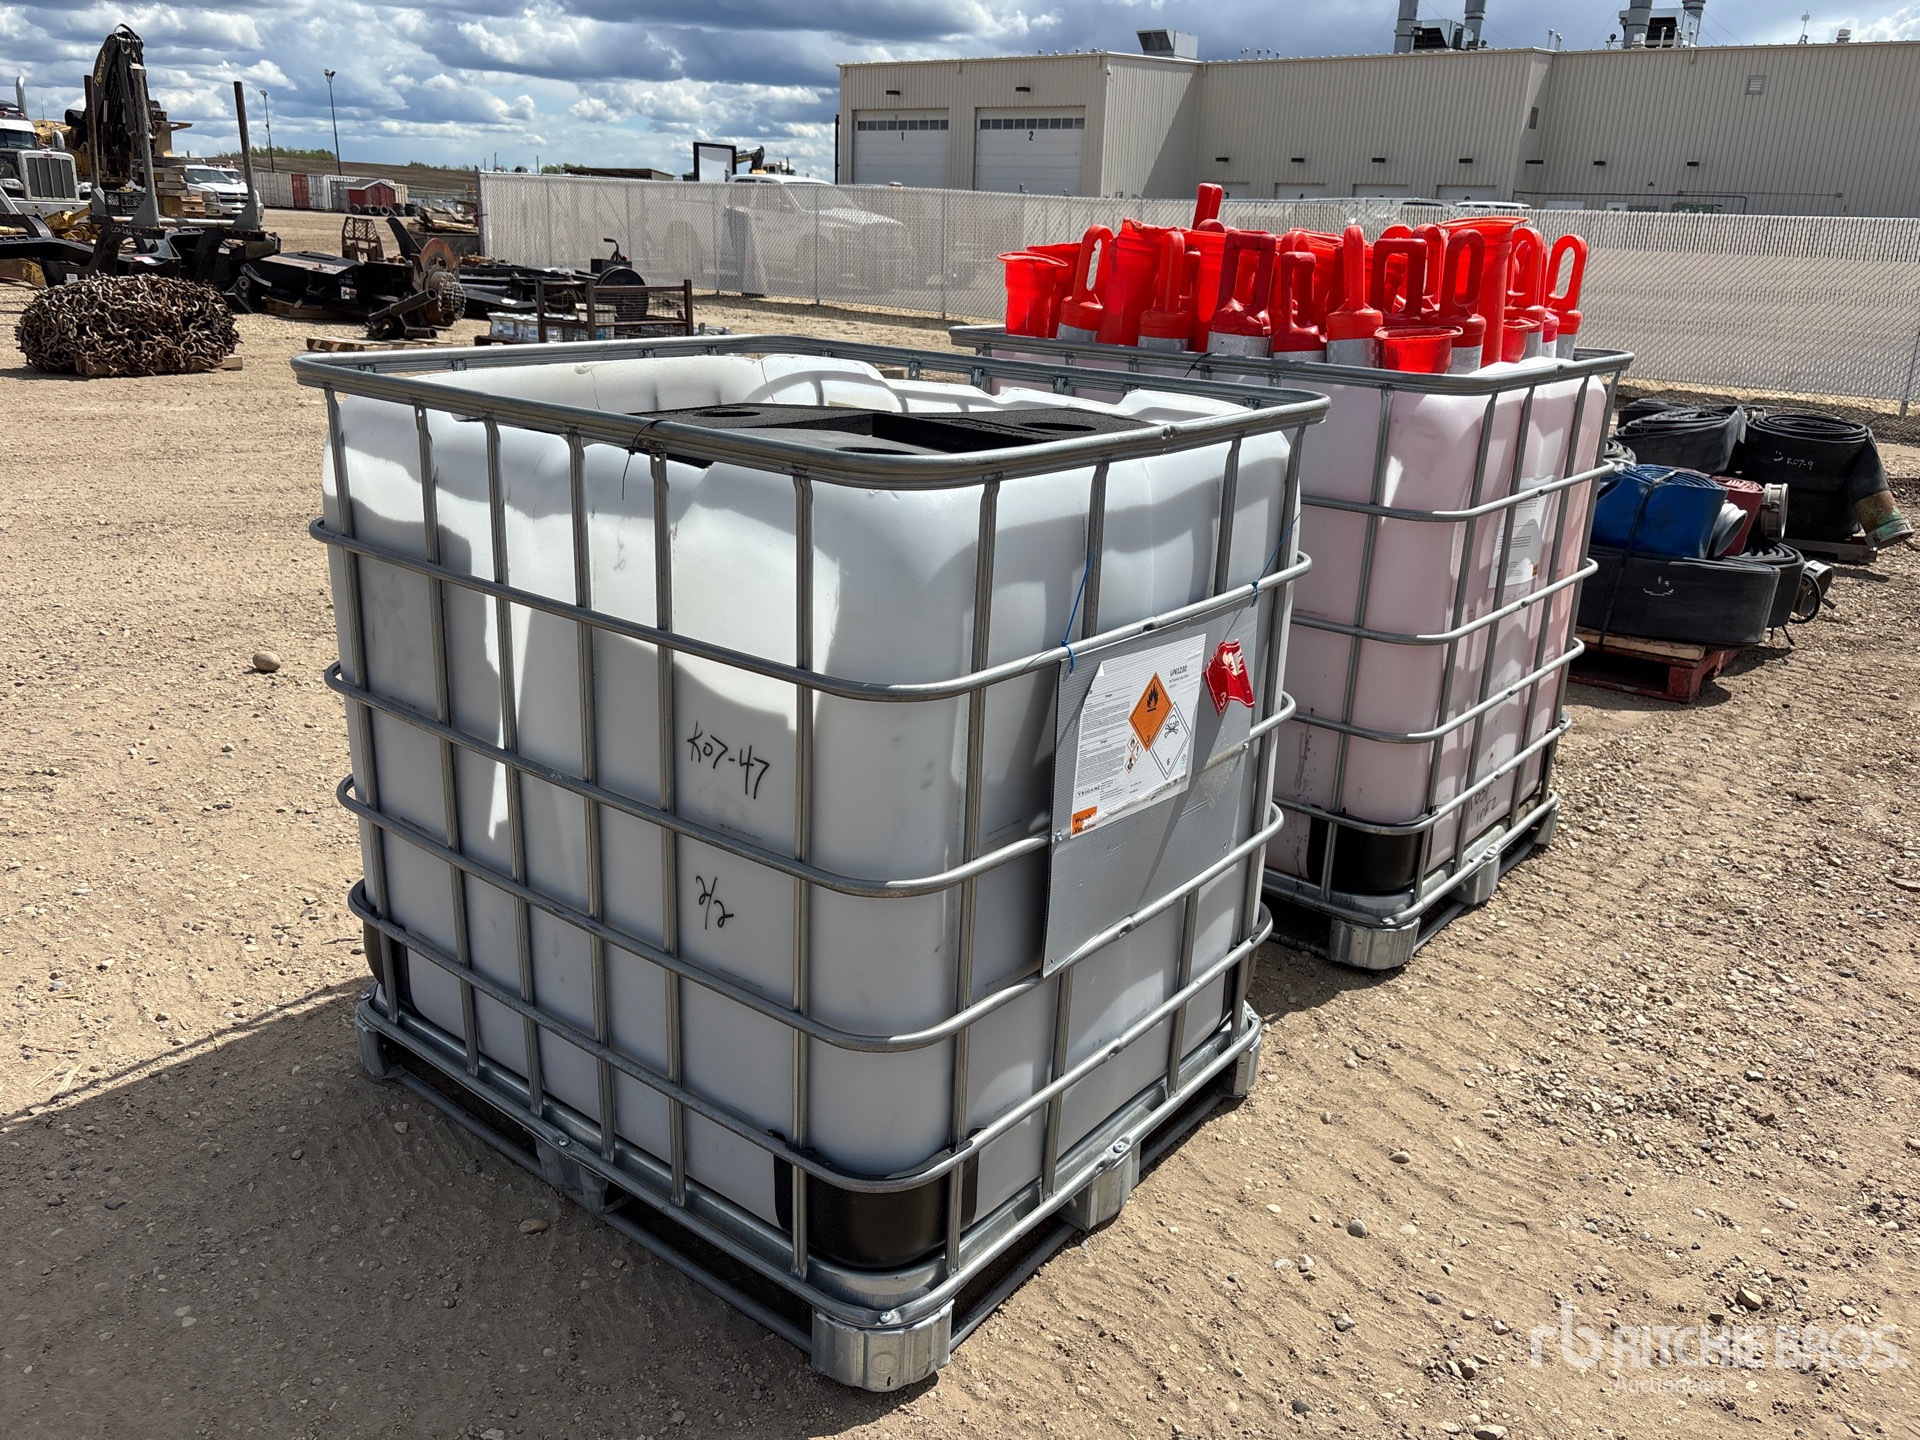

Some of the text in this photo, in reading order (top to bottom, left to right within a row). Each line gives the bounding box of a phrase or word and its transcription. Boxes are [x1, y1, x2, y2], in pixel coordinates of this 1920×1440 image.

[901, 131, 905, 141] 1
[1028, 131, 1034, 141] 2
[1220, 692, 1227, 707] 3
[686, 721, 771, 800] K07-47
